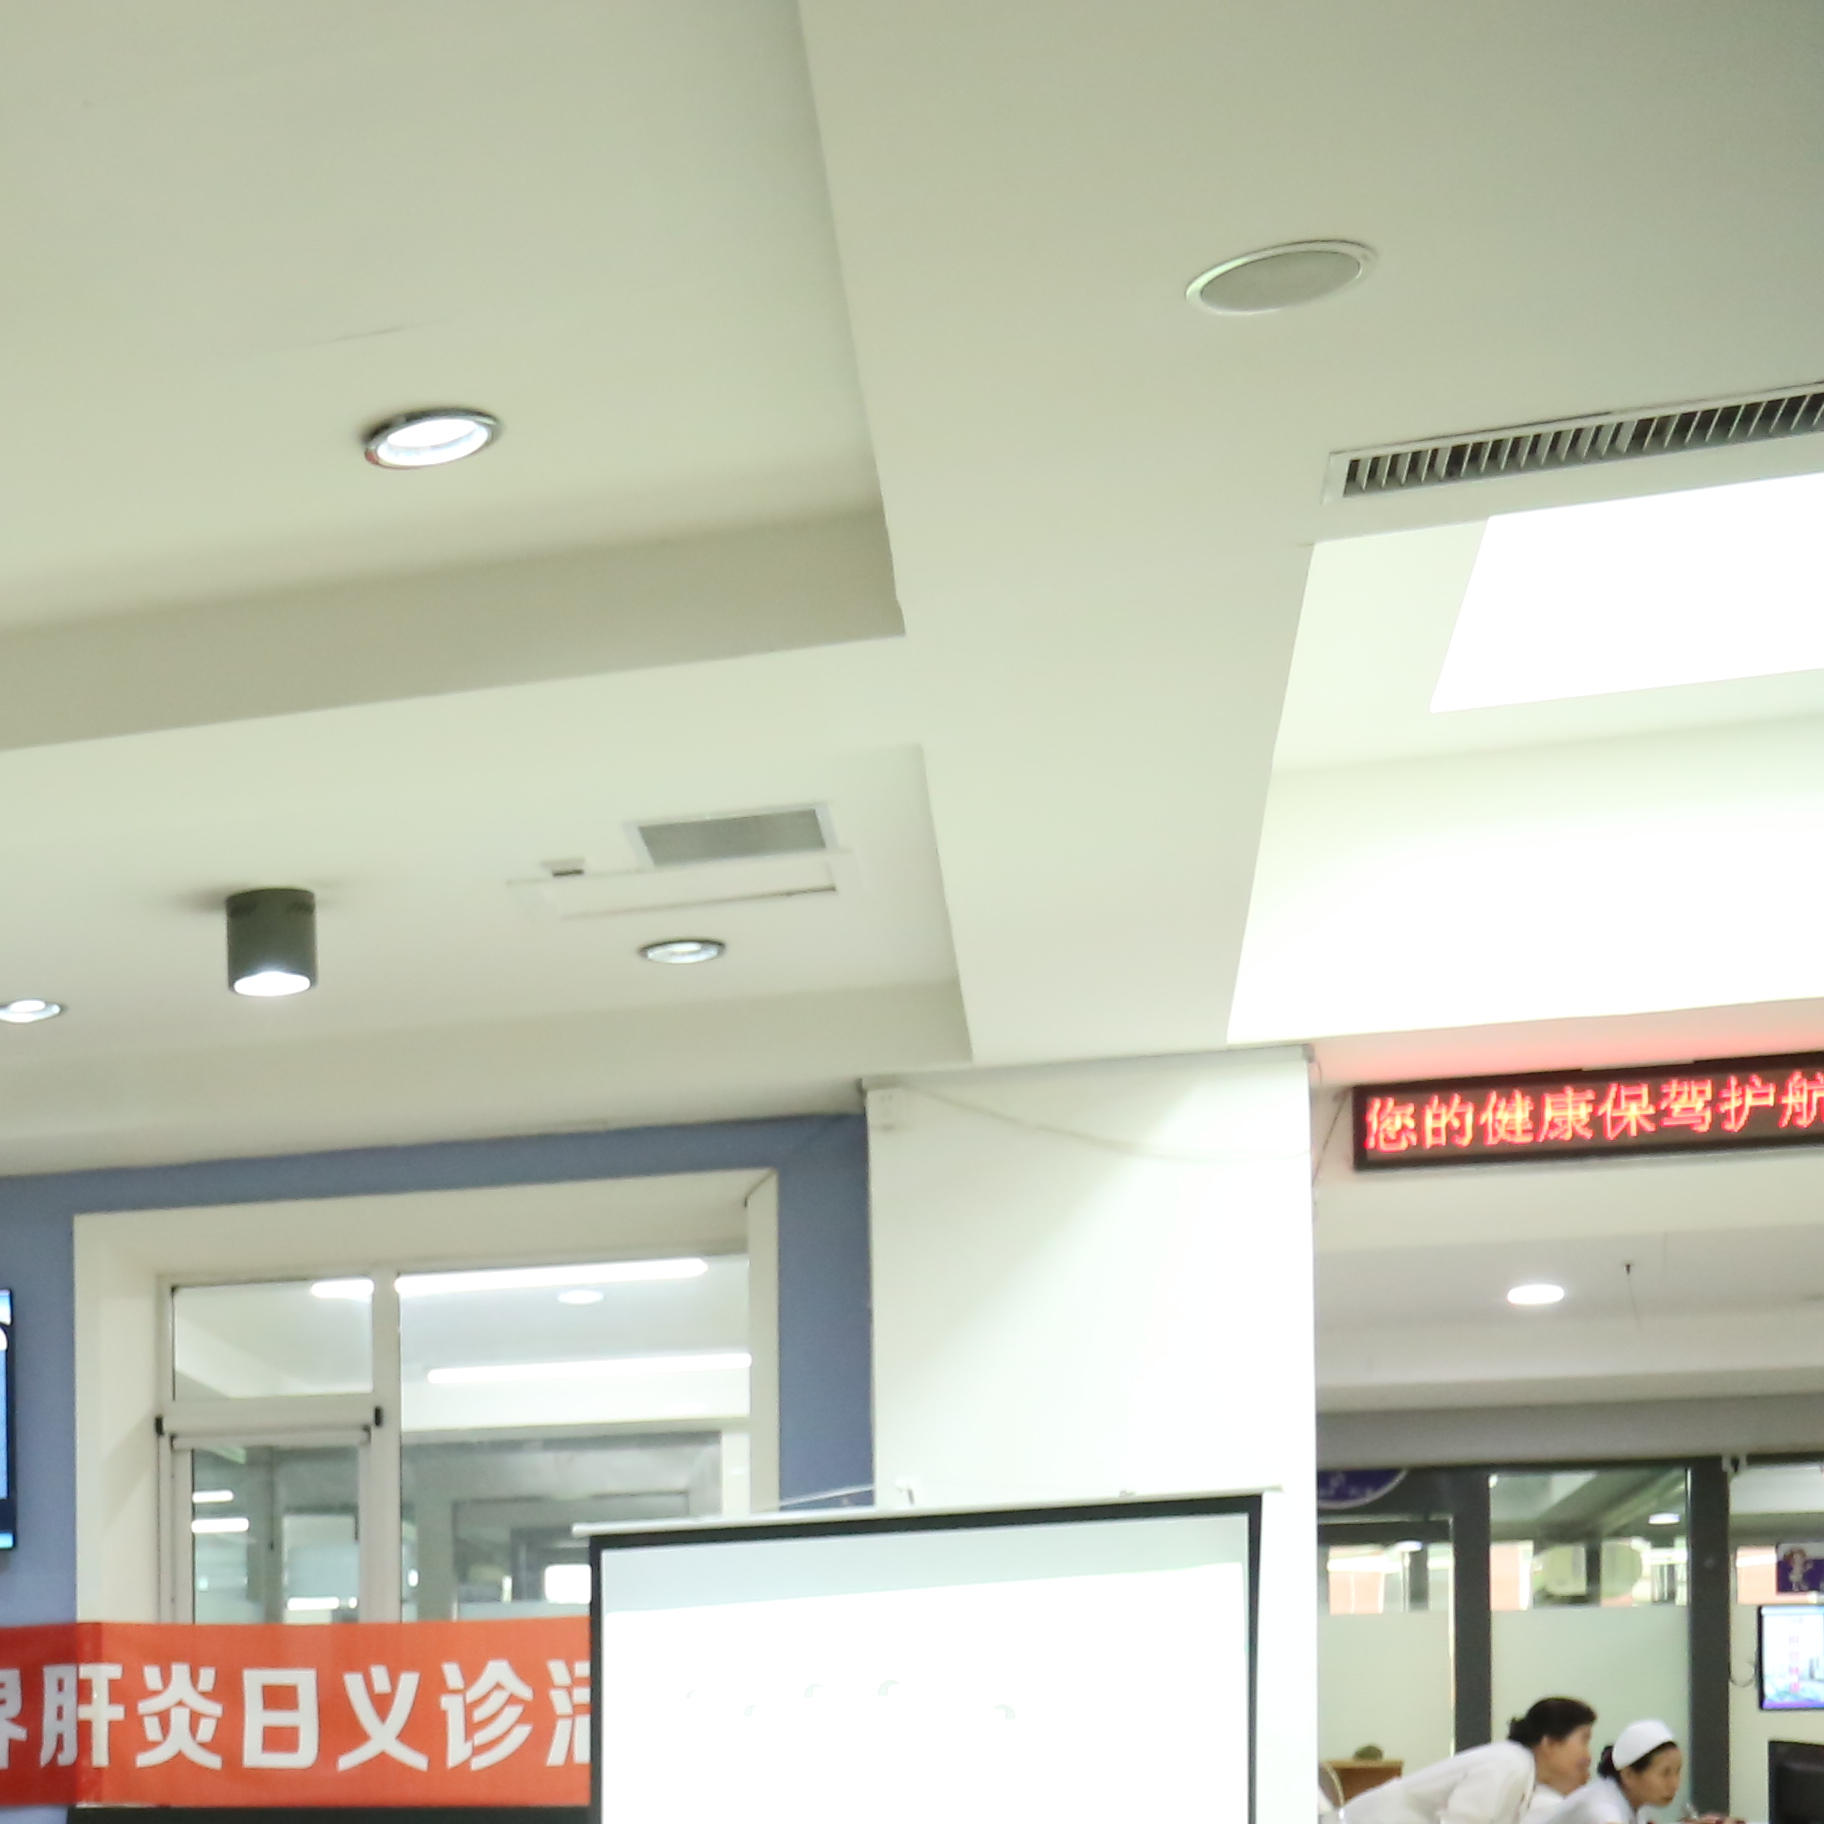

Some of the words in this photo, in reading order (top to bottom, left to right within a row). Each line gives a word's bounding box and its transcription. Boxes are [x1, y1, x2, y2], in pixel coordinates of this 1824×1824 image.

[1364, 1070, 1824, 1153] 您的健康保驾护航
